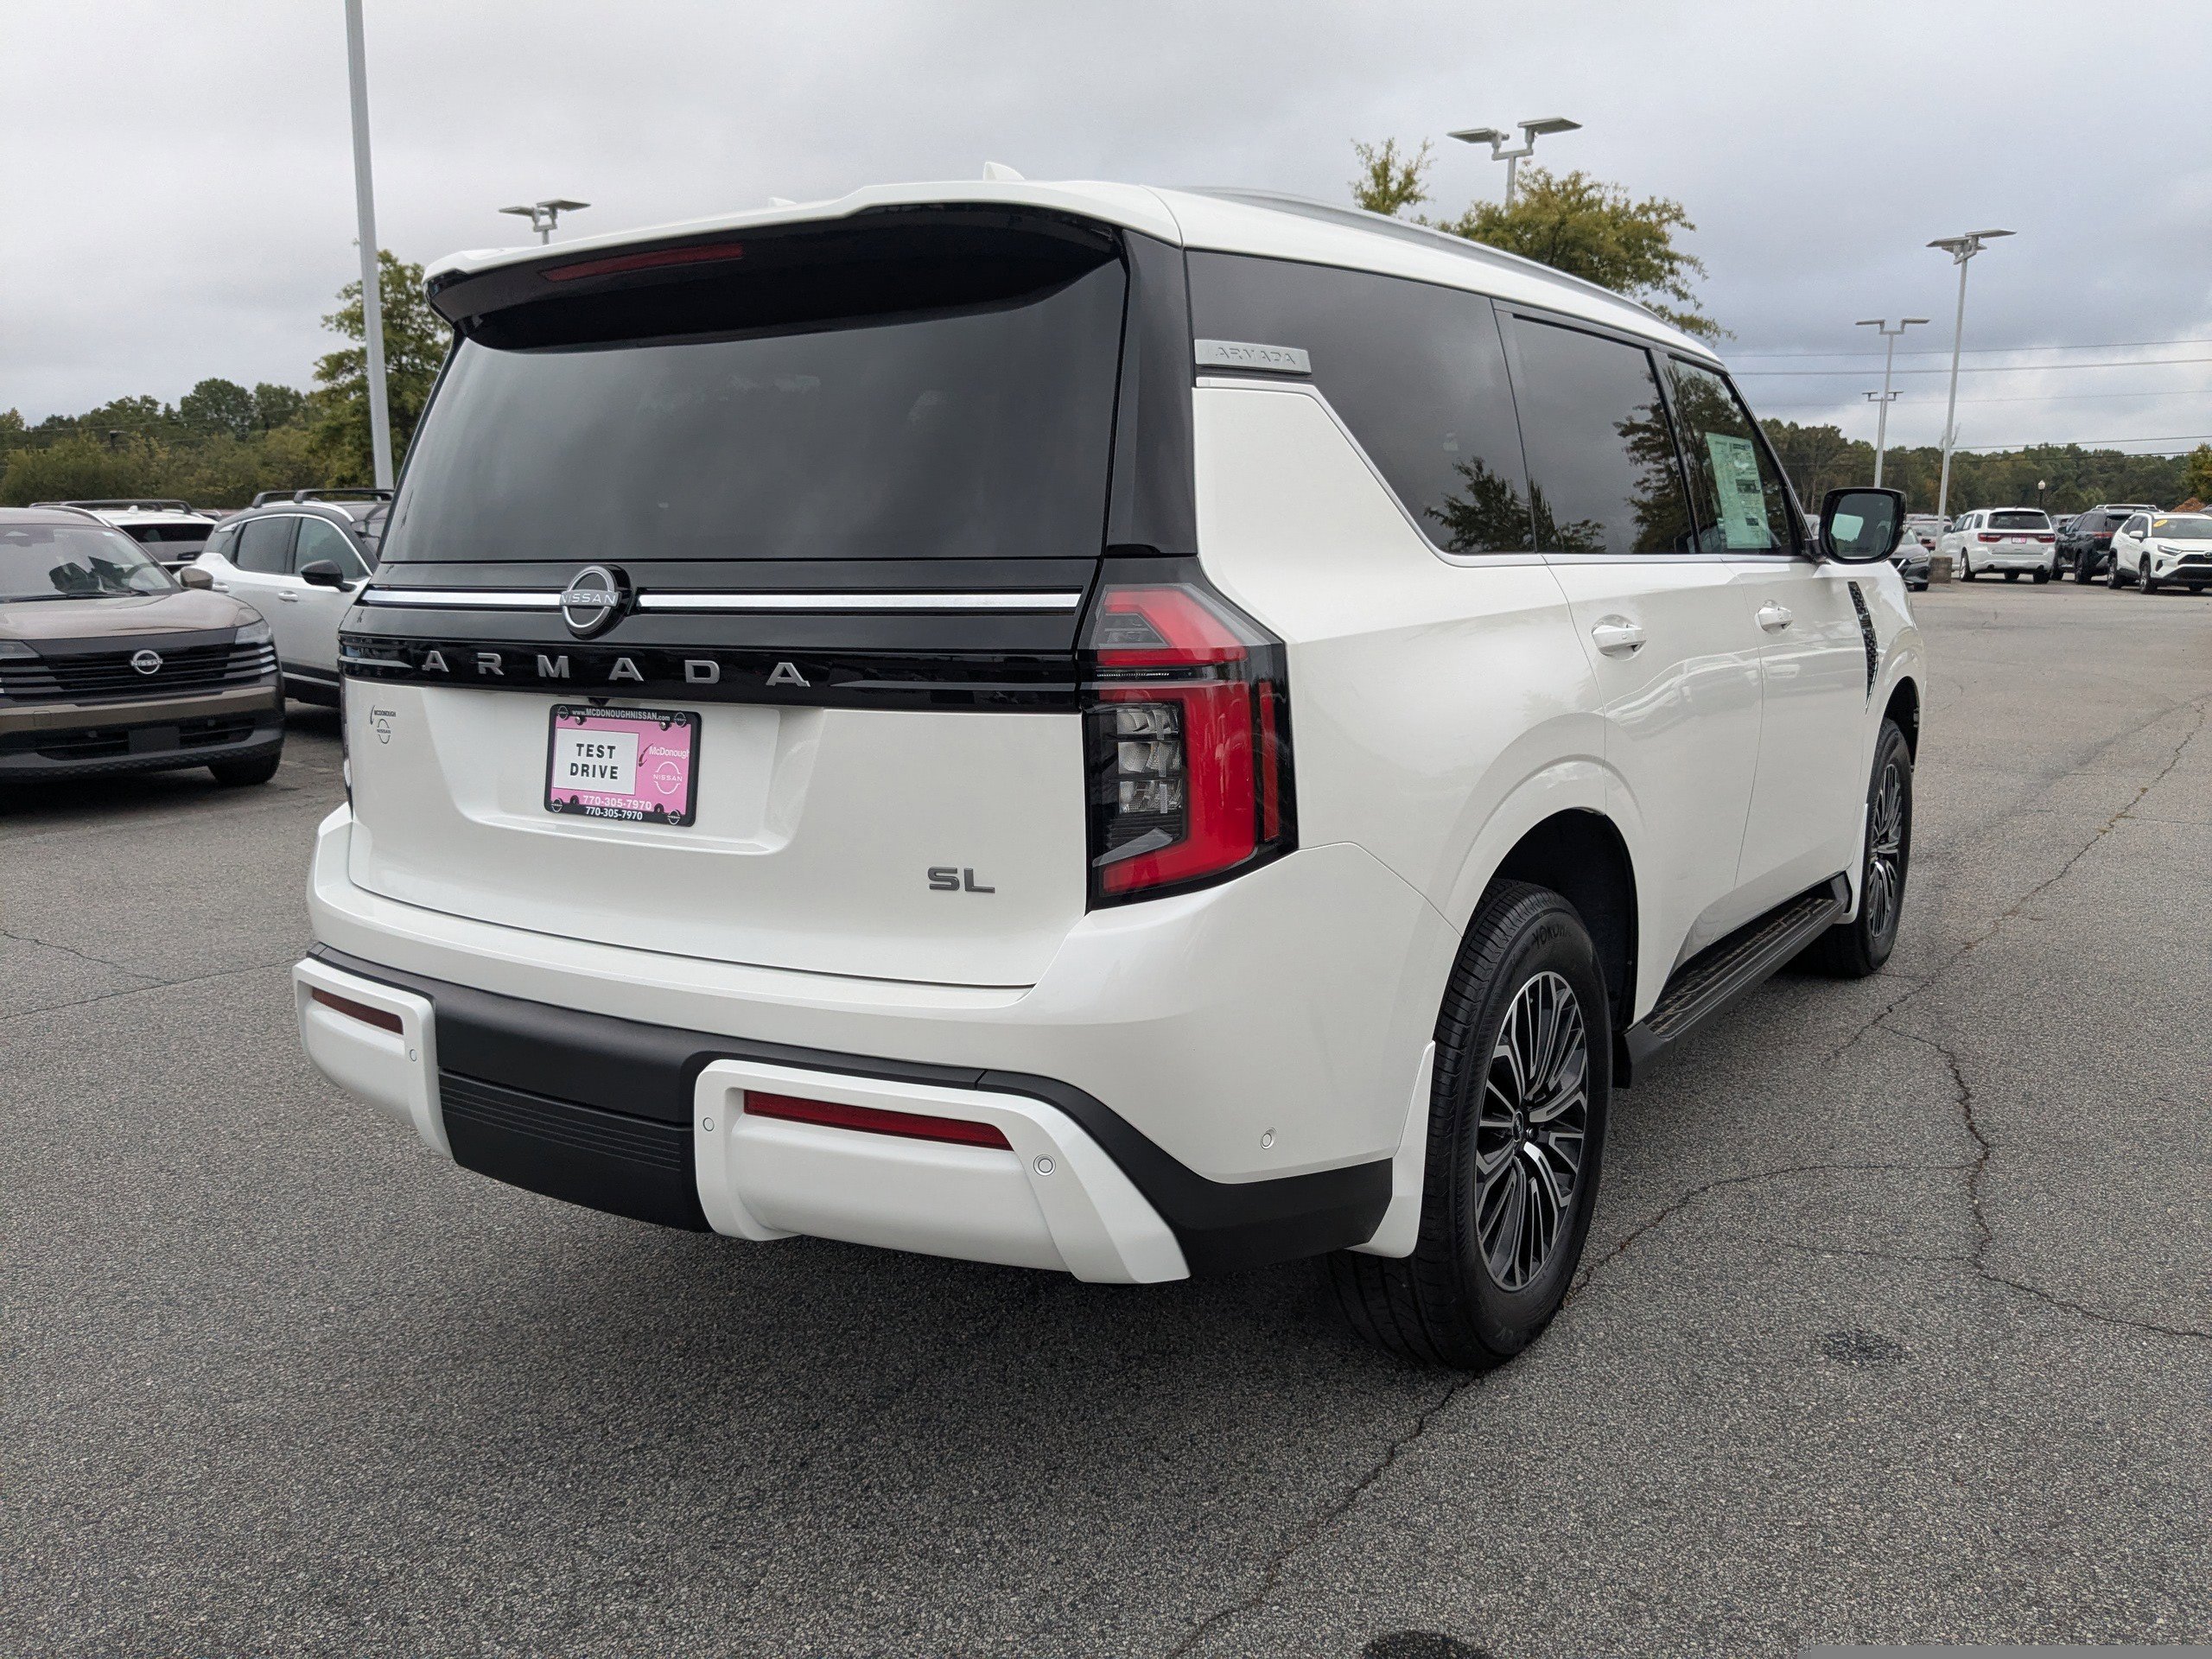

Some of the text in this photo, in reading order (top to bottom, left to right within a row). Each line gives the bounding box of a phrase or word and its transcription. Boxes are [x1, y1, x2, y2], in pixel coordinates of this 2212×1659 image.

[561, 593, 616, 604] NISSAN
[422, 650, 810, 687] ARMADA
[576, 743, 616, 759] TEST
[569, 762, 619, 779] DRIVE
[652, 773, 683, 782] NISSAN
[586, 806, 643, 820] 770-305-7970
[927, 866, 995, 893] SL
